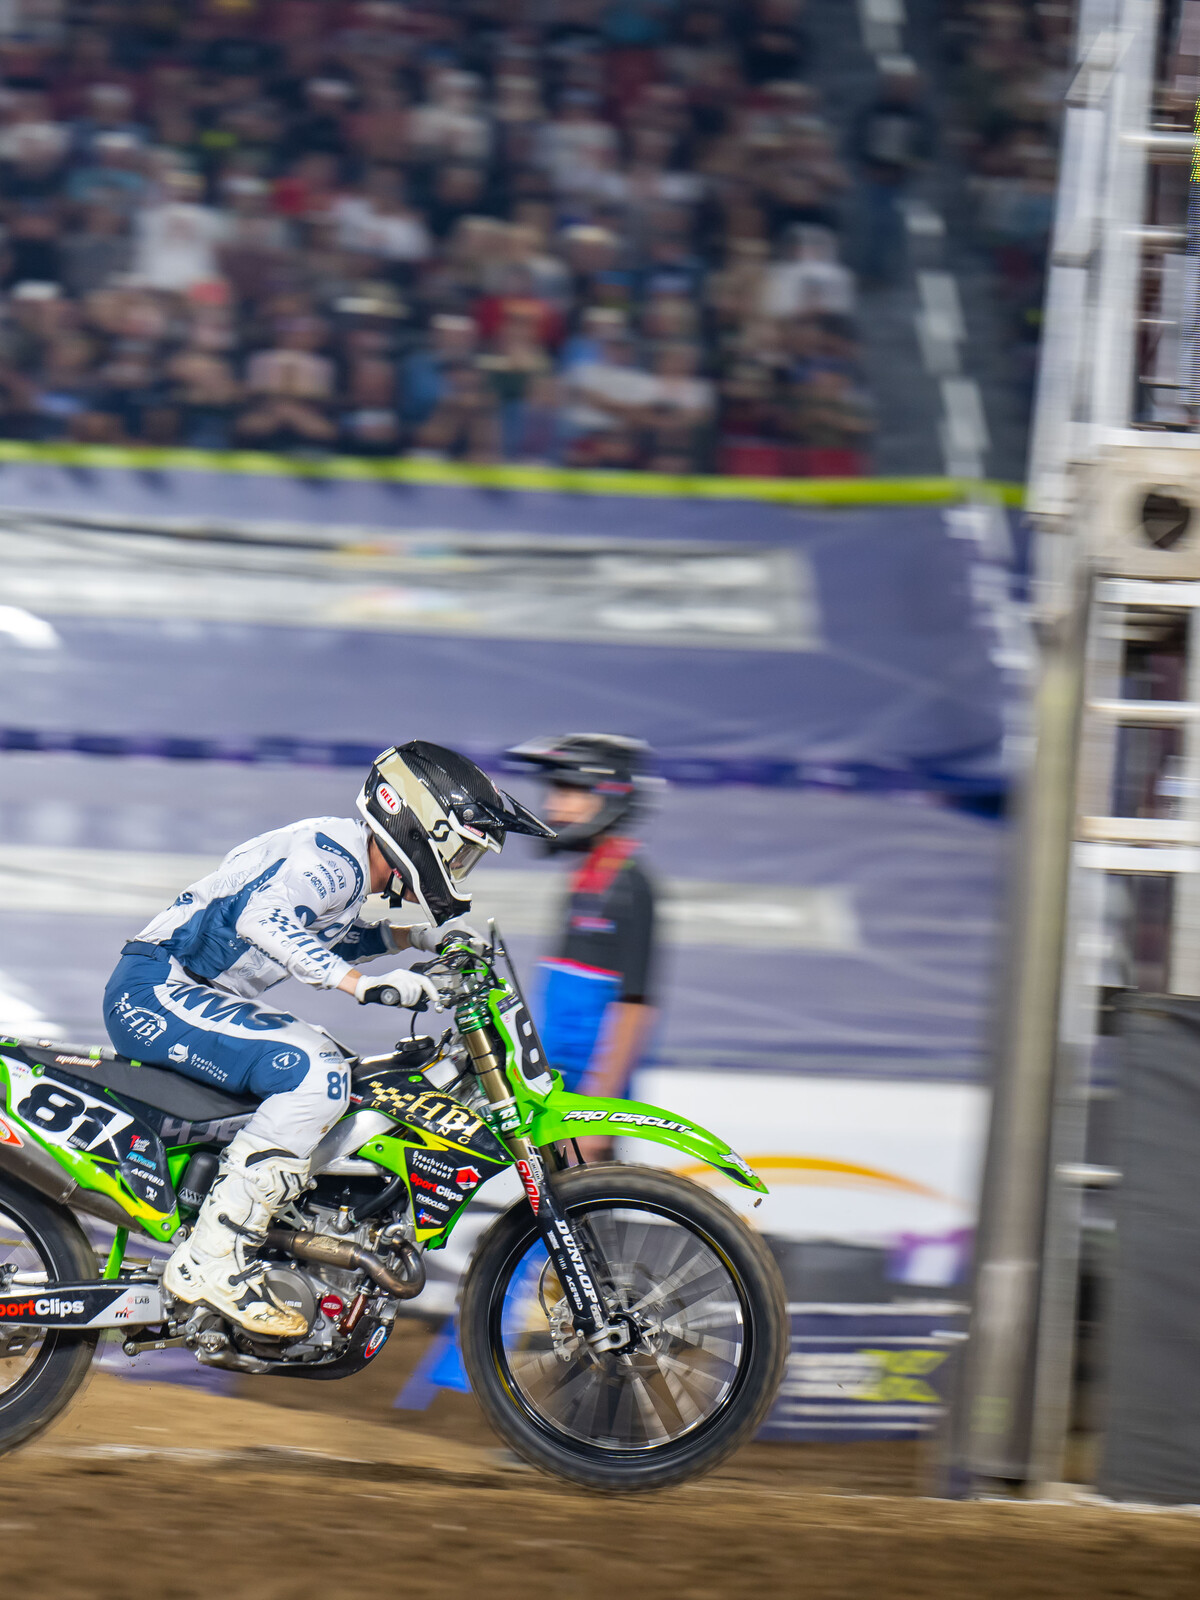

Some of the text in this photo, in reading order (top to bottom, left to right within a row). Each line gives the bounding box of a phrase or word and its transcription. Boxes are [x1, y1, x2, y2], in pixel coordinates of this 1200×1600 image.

[379, 787, 397, 811] BELL
[333, 866, 347, 890] LAB
[122, 1007, 166, 1043] HBI
[190, 1060, 226, 1083] Treatment
[191, 1053, 229, 1078] Beachview
[327, 1071, 349, 1102] 81
[17, 1083, 118, 1151] 81
[370, 1100, 472, 1145] RACING
[406, 1094, 486, 1138] HBI
[562, 1110, 695, 1134] PRO CIRCUIT
[411, 1158, 453, 1180] Treatment
[413, 1150, 455, 1173] Beachview
[130, 1167, 166, 1187] ACERBIS
[555, 1219, 599, 1304] DUNLOP
[134, 1296, 150, 1305] LAB
[564, 1274, 585, 1311] ACERBIS
